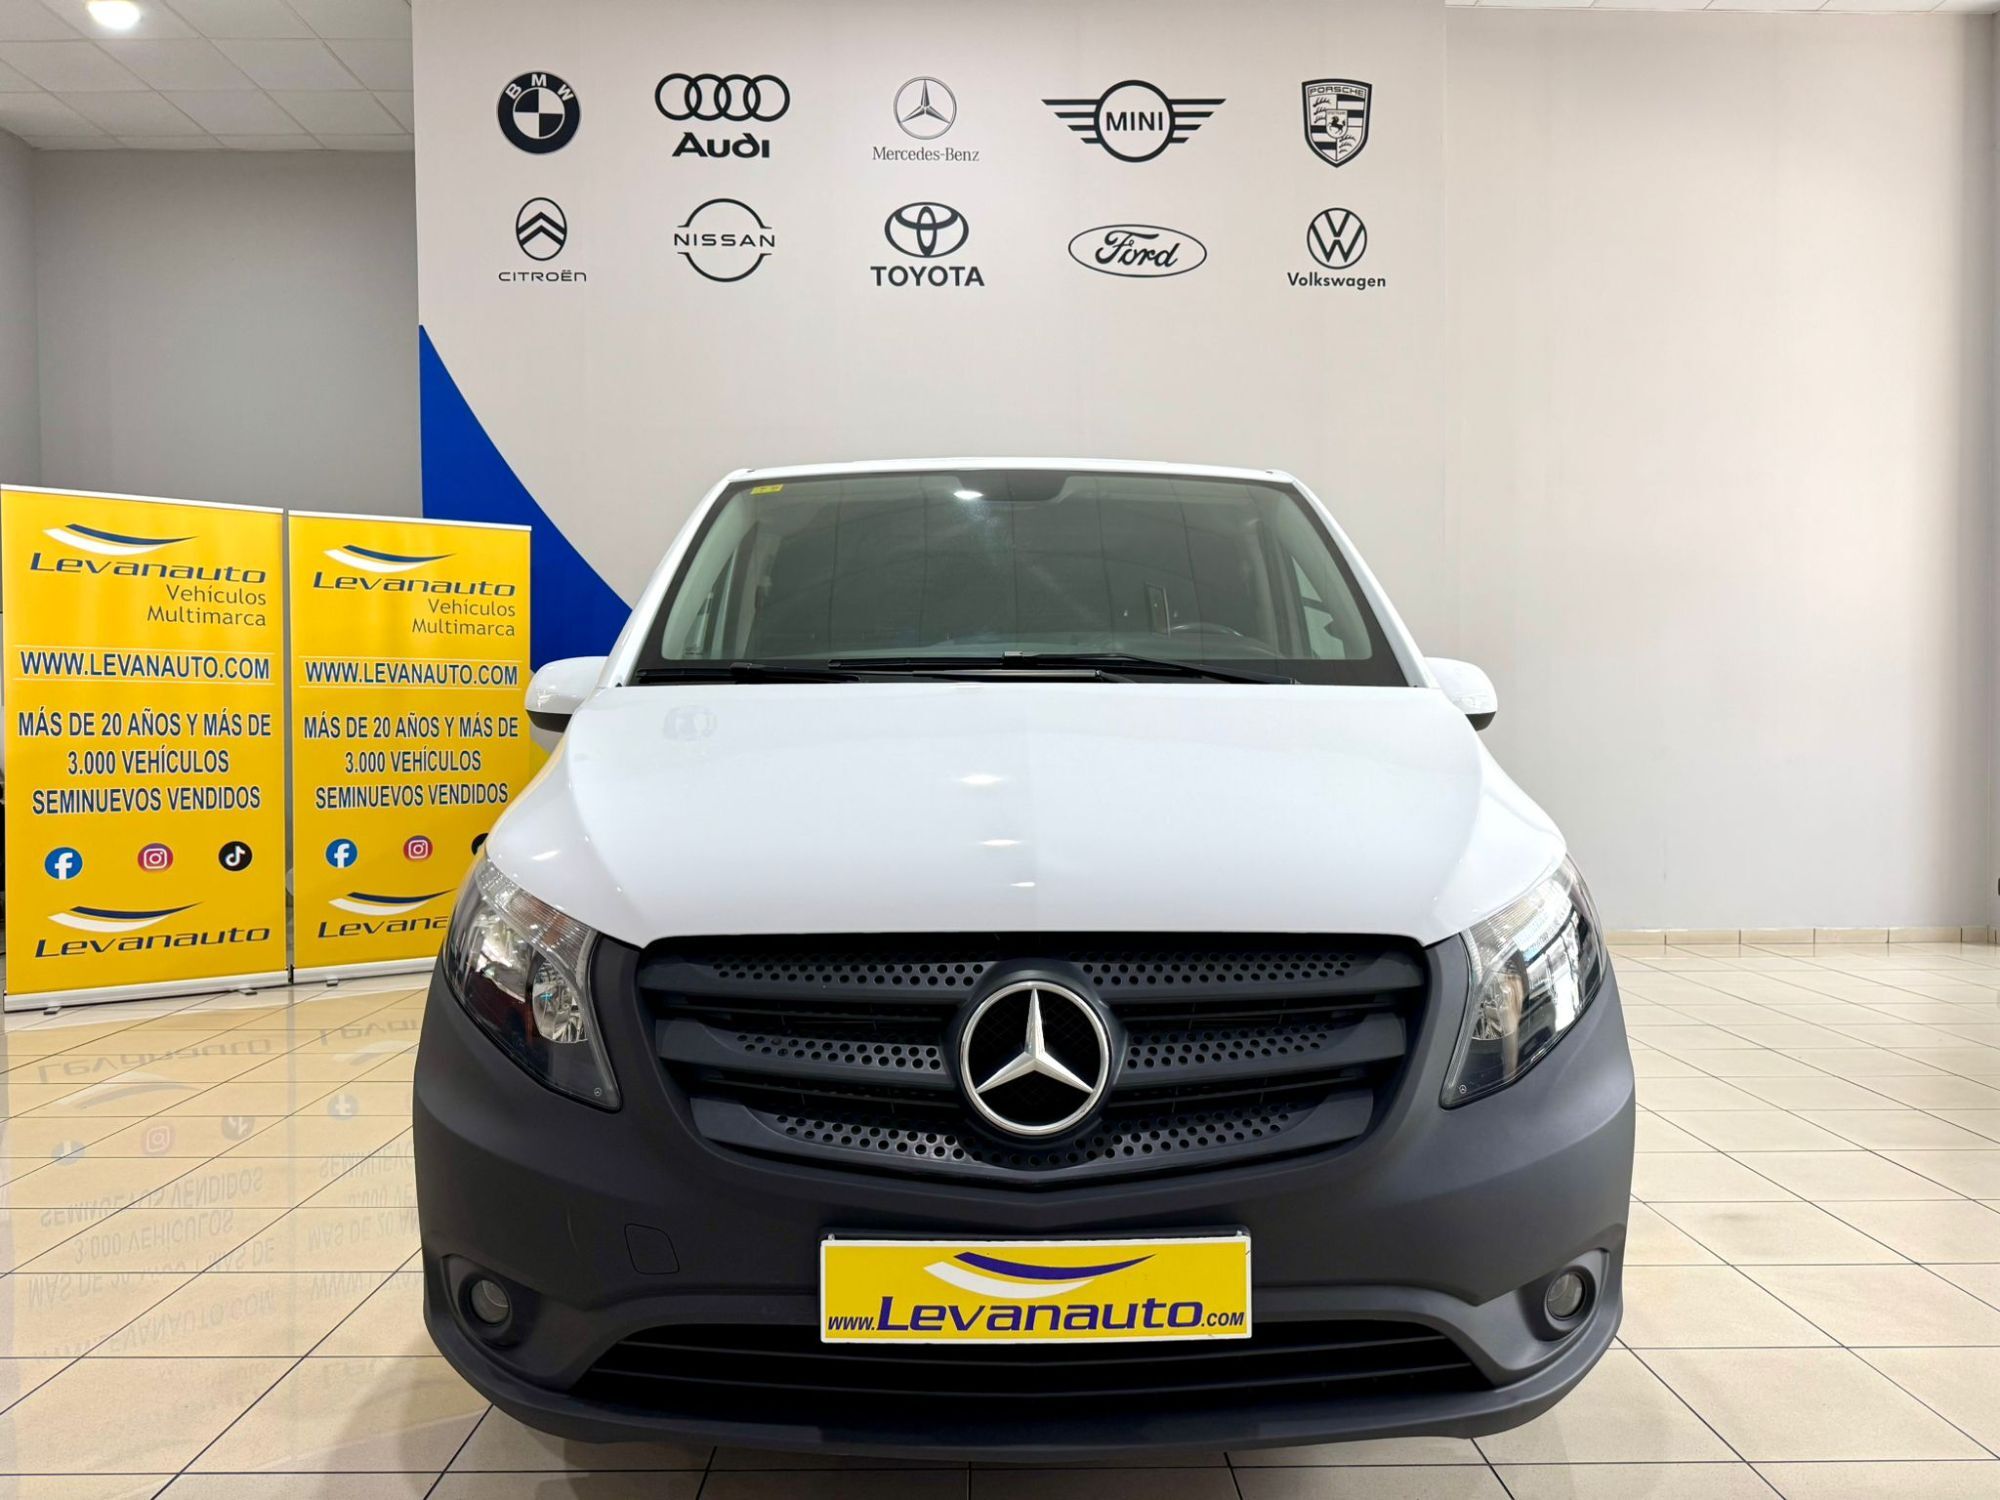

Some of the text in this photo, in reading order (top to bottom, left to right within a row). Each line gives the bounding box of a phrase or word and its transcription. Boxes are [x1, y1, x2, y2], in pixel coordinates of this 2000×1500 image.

[505, 73, 575, 101] BMW
[1309, 85, 1365, 97] PORSCHE
[1105, 111, 1164, 132] MINI
[671, 132, 770, 158] Audi
[872, 146, 980, 162] Mercedes-Benz
[674, 233, 776, 249] NISSAN
[1095, 229, 1181, 267] Ford
[870, 265, 985, 287] TOYOTA
[1287, 271, 1386, 290] Volkswagen
[30, 552, 266, 584] Levanauto
[166, 584, 266, 605] Vehículos
[313, 571, 516, 597] Levanauto
[147, 605, 266, 627] Multimarca
[428, 598, 516, 617] Vehículos
[412, 618, 515, 637] Multimarca
[20, 651, 269, 679] WWW.LEVANAUTO.COM
[305, 661, 518, 685] WWW.LEVANAUTO.COM
[18, 706, 271, 736] MÁS DE 20 AÑOS Y MÁS DE
[304, 711, 518, 738] MÁS DE 20 AÑOS Y MÁS DE
[68, 745, 229, 775] 3.000 VEHÍCULOS
[345, 746, 481, 773] 3.000 VEHÍCULOS
[32, 786, 261, 814] SEMINUEVOS VENDIDOS
[316, 783, 508, 809] SEMINUEVOS VENDIDOS
[317, 916, 449, 939] Levana
[35, 926, 270, 959] Levanauto
